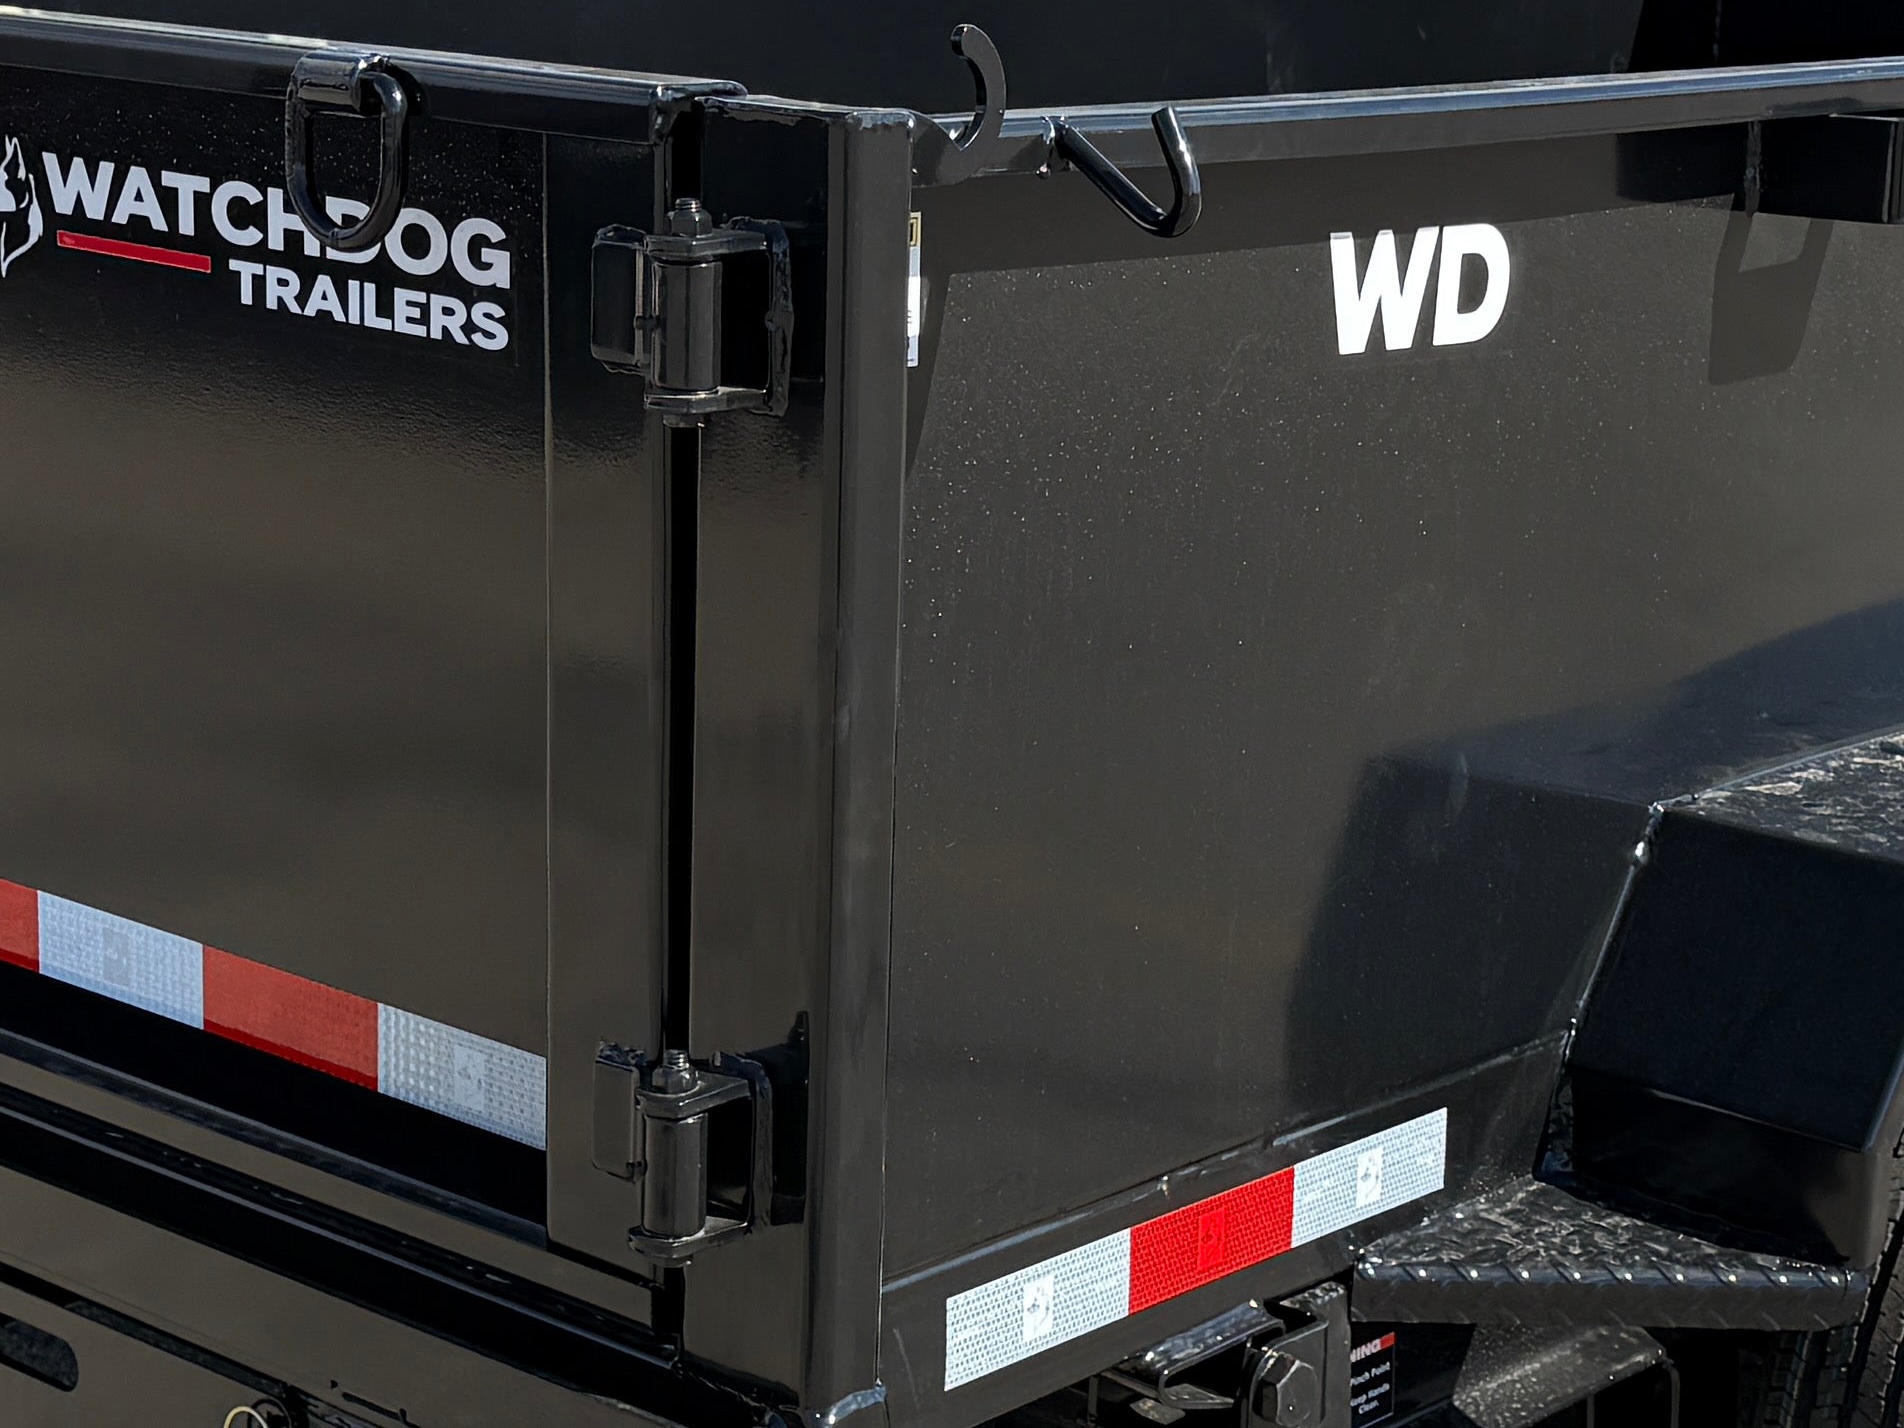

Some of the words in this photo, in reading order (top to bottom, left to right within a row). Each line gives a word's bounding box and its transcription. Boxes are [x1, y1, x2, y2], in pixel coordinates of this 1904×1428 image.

[41, 152, 511, 289] WATCHDOG
[228, 259, 509, 351] TRAILERS
[1329, 224, 1510, 355] WD
